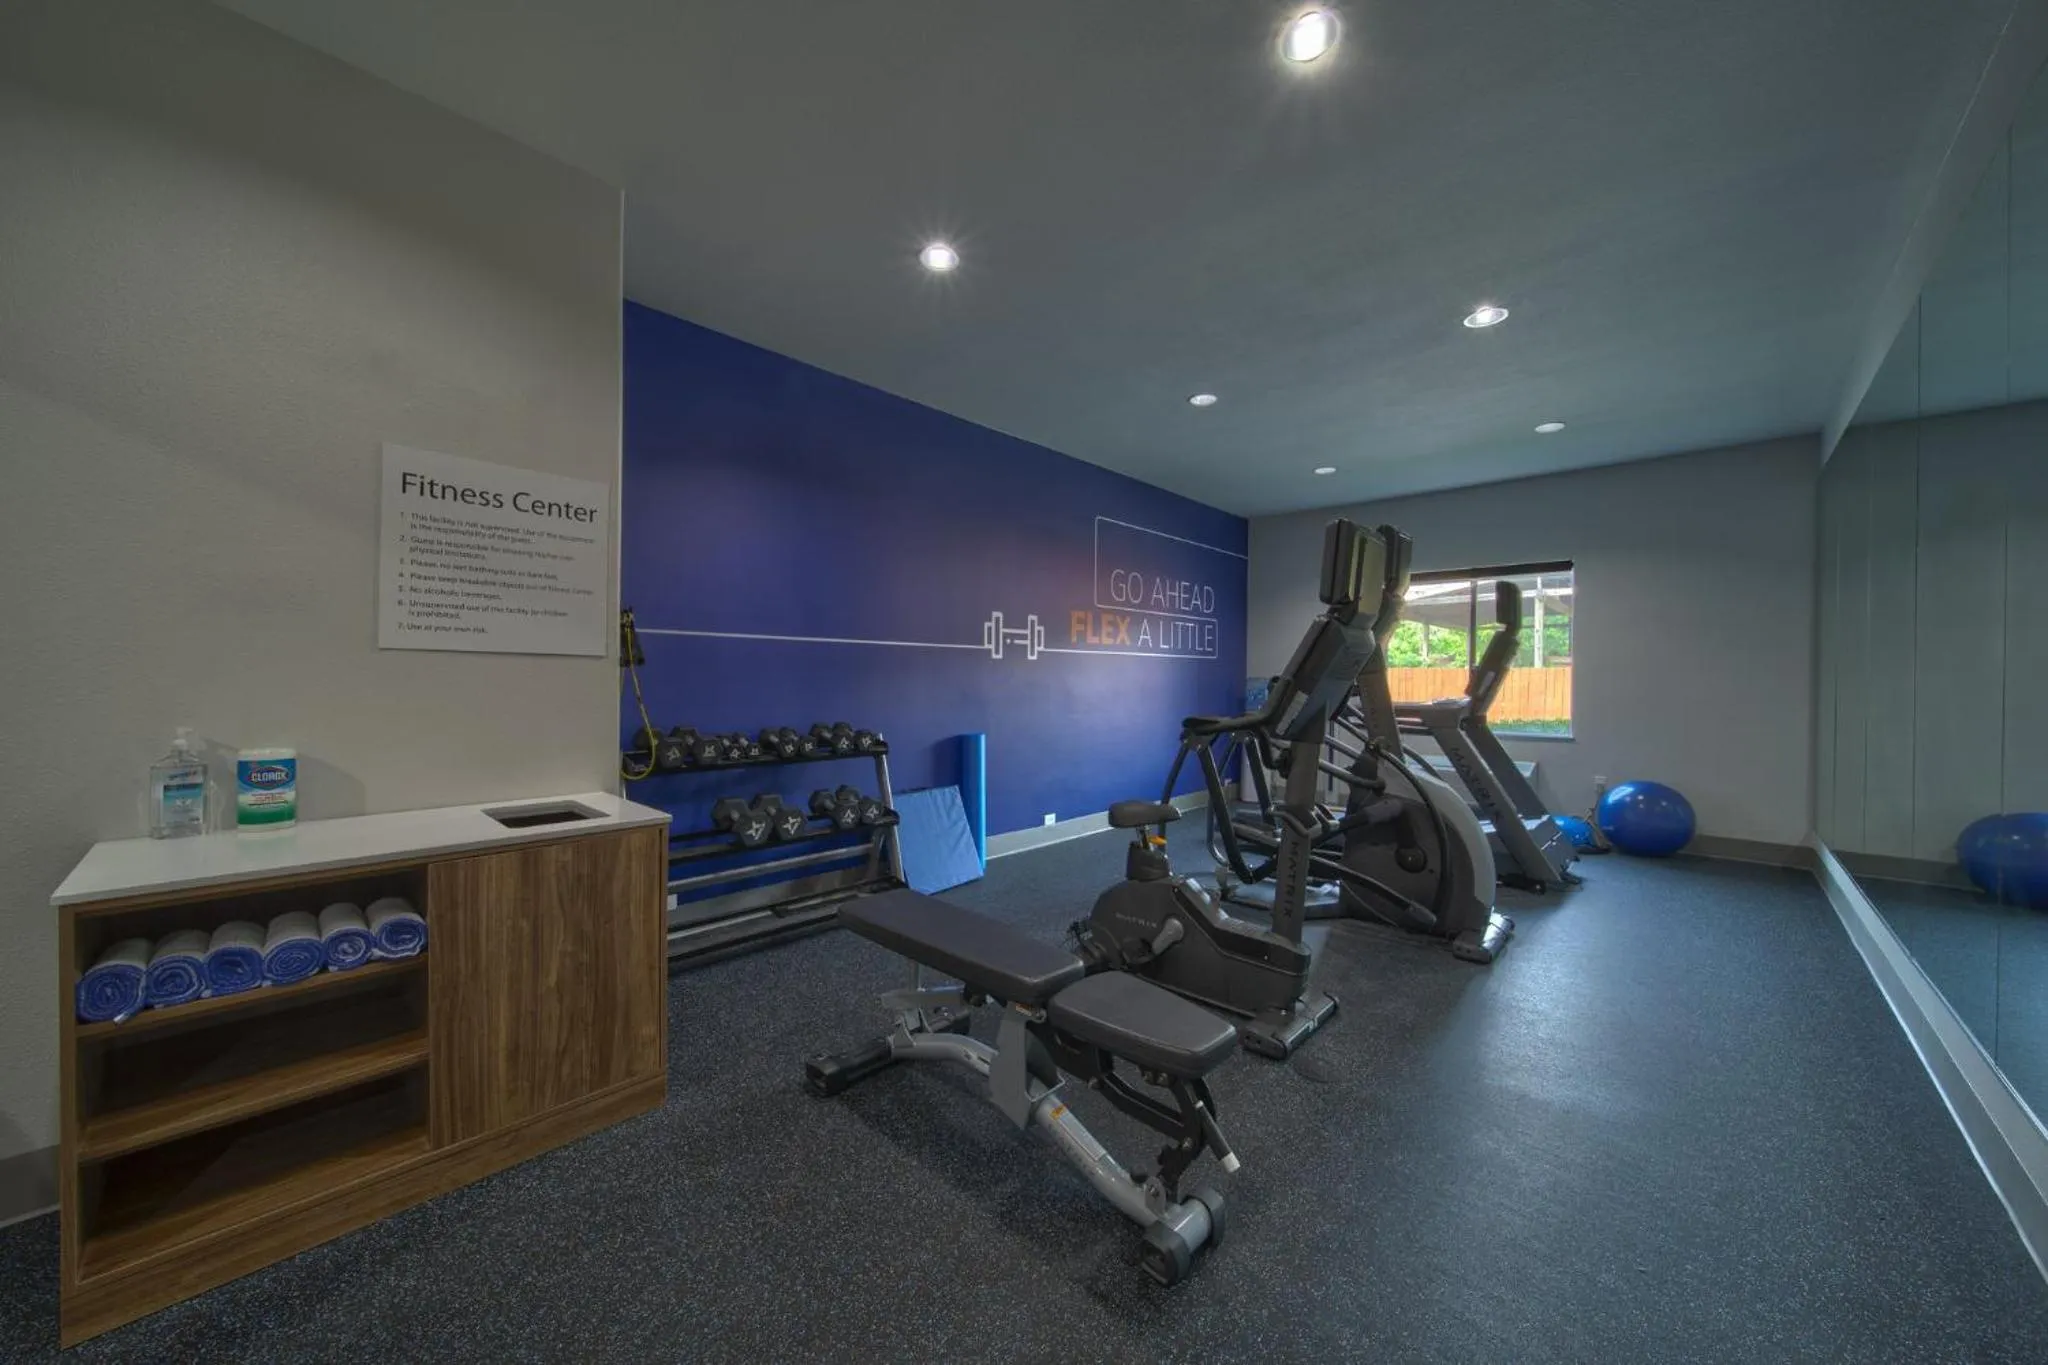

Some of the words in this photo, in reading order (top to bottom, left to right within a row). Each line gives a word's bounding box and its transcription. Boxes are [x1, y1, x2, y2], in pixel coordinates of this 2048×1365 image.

[401, 471, 505, 509] Fitness
[512, 491, 599, 524] Center
[1110, 568, 1143, 604] GO
[1151, 576, 1215, 614] AHEAD
[1070, 609, 1131, 646] FLEX
[1137, 618, 1153, 649] A
[1159, 620, 1214, 652] LITTLE
[251, 769, 289, 784] CLOROX
[1283, 841, 1300, 918] MATRIX
